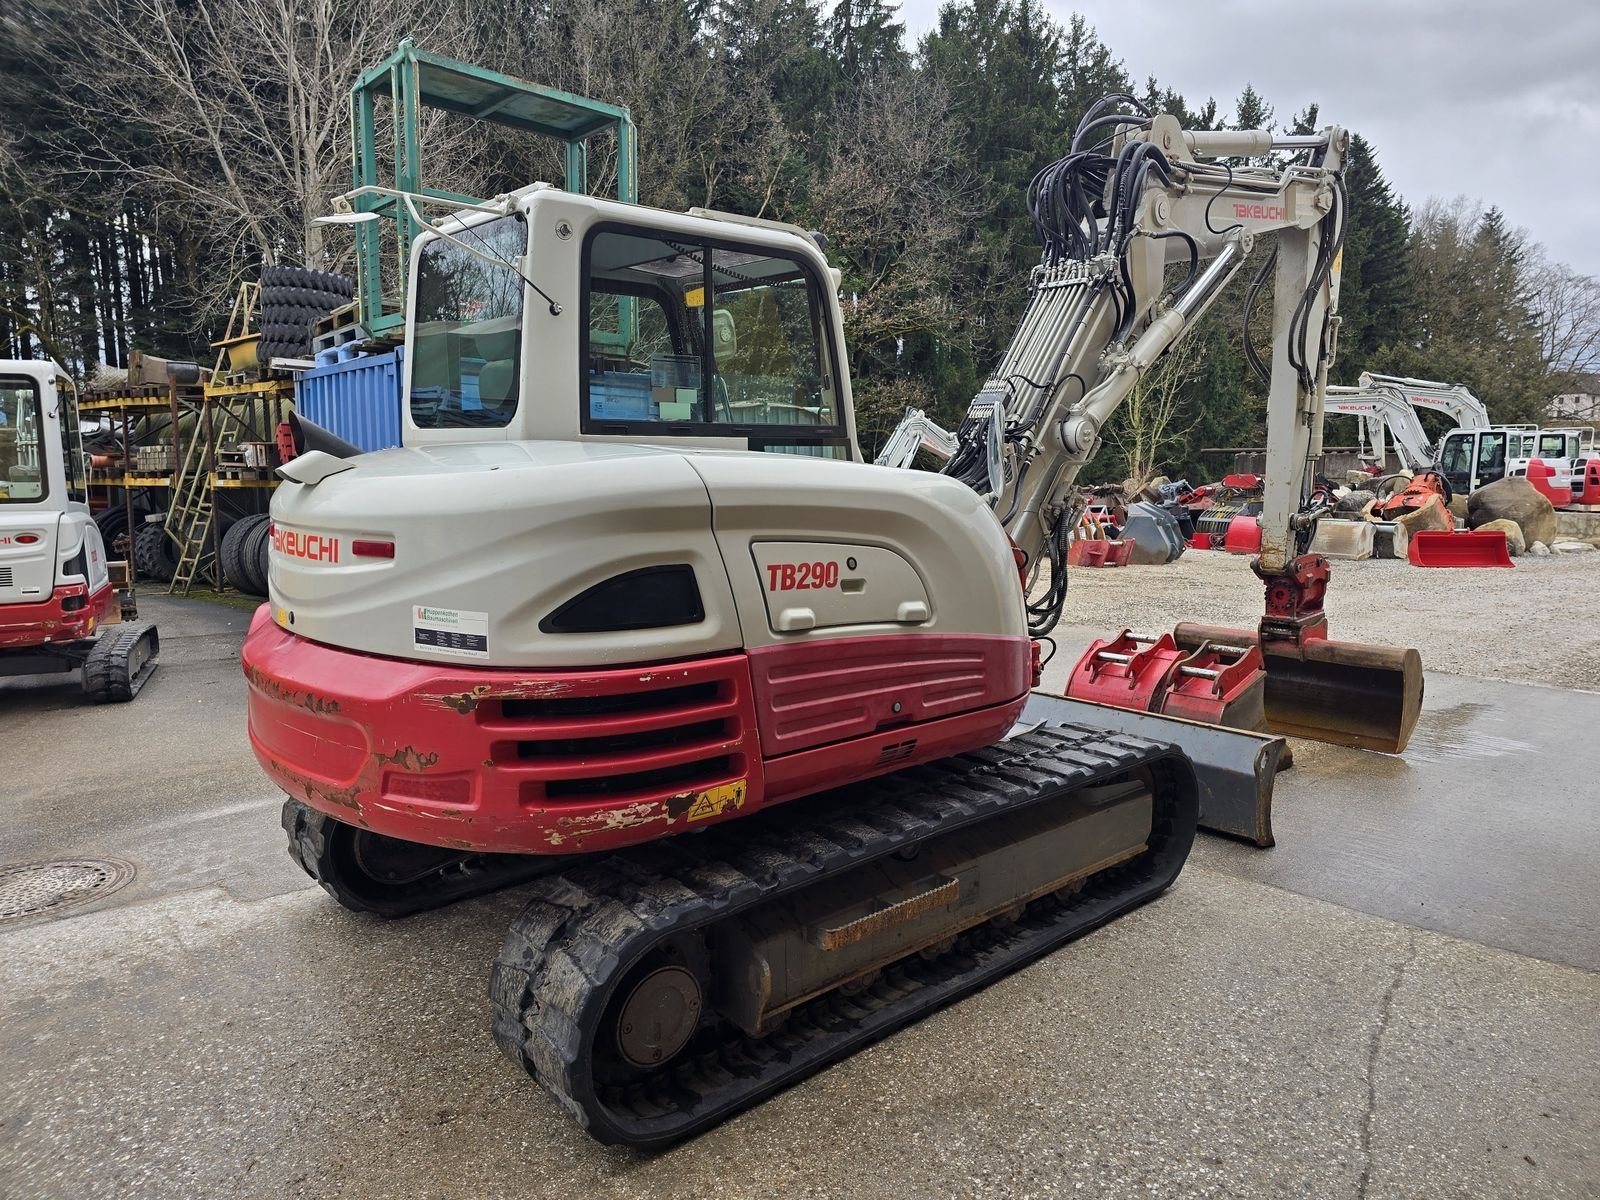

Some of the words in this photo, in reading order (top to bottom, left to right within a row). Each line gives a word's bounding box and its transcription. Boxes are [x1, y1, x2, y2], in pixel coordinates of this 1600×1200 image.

[1232, 204, 1286, 220] TAKEUCHI
[1411, 396, 1445, 405] TAKEUCHI
[767, 561, 839, 592] TB290
